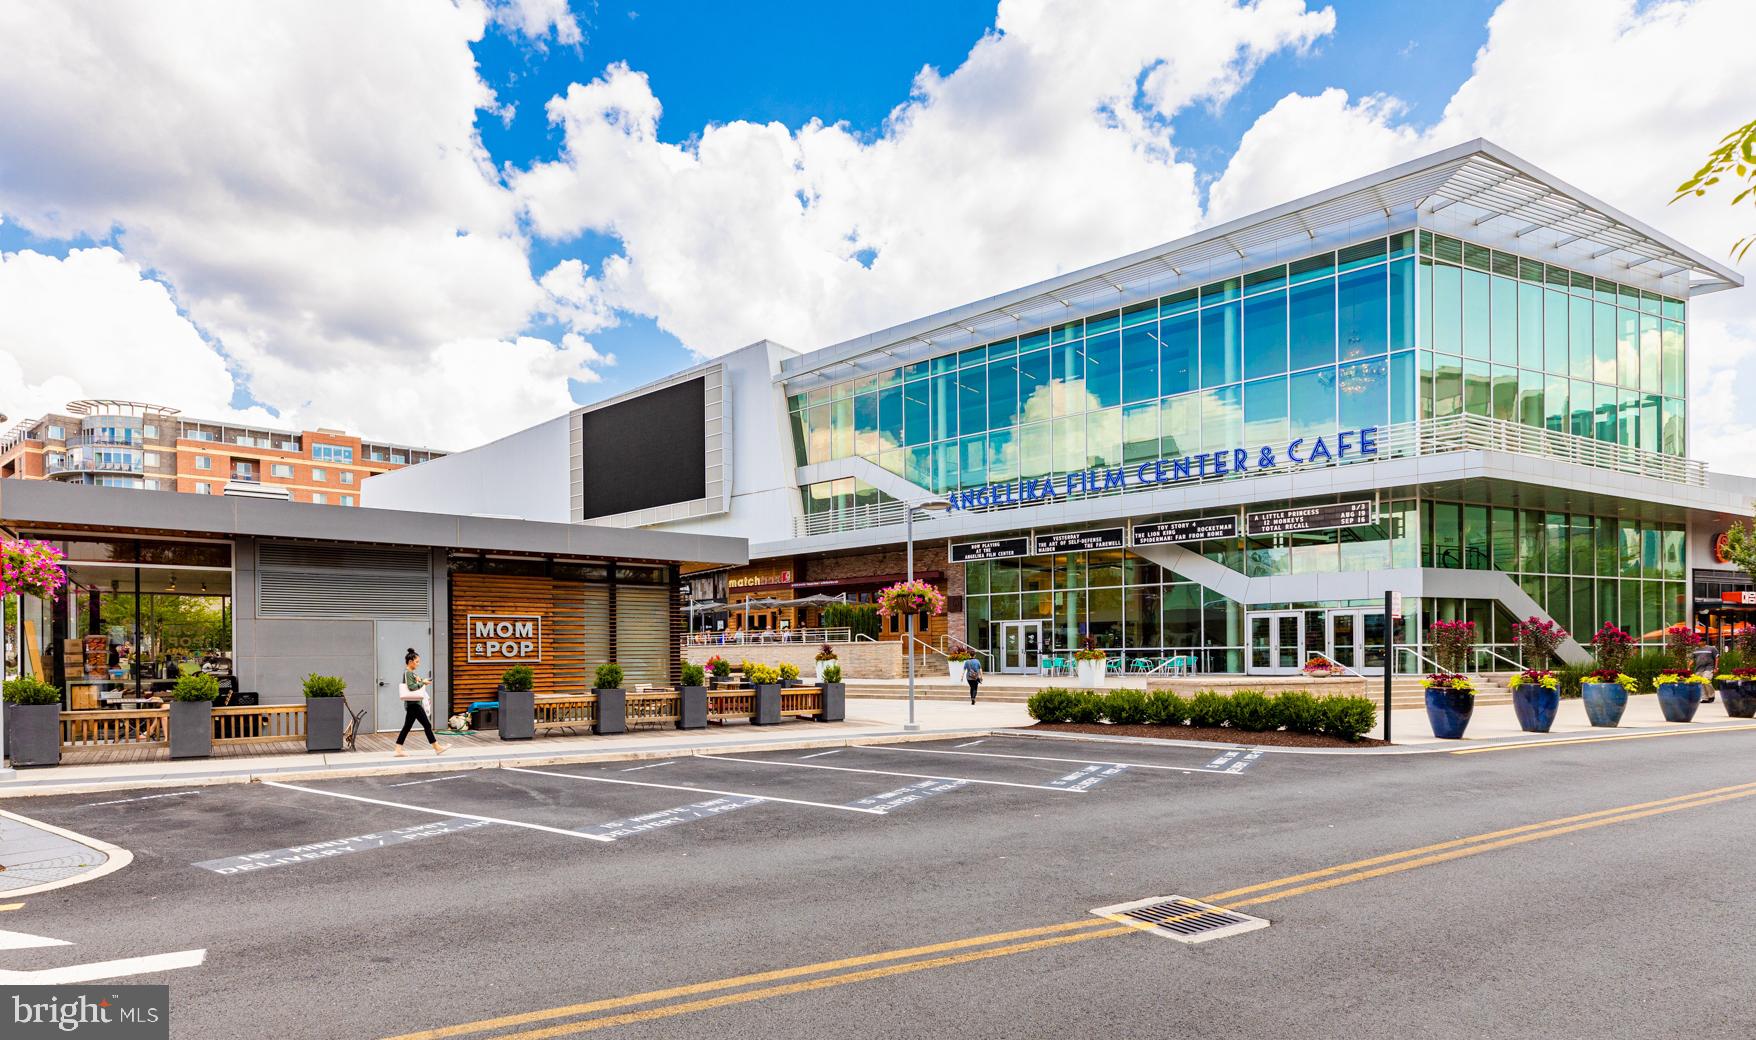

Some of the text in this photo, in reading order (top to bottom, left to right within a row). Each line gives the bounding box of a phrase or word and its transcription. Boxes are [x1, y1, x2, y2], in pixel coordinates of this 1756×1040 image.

[946, 427, 1378, 512] ANGELIKA FILM CENTER & CAFE
[1288, 509, 1320, 518] PRINCESS
[1273, 517, 1304, 525] MONKEYS
[1197, 524, 1232, 532] ROCKETMAN
[1095, 540, 1121, 548] FAREWELL
[475, 621, 533, 638] MOM
[475, 641, 534, 657] & POP
[214, 846, 355, 875] DELIVERY
